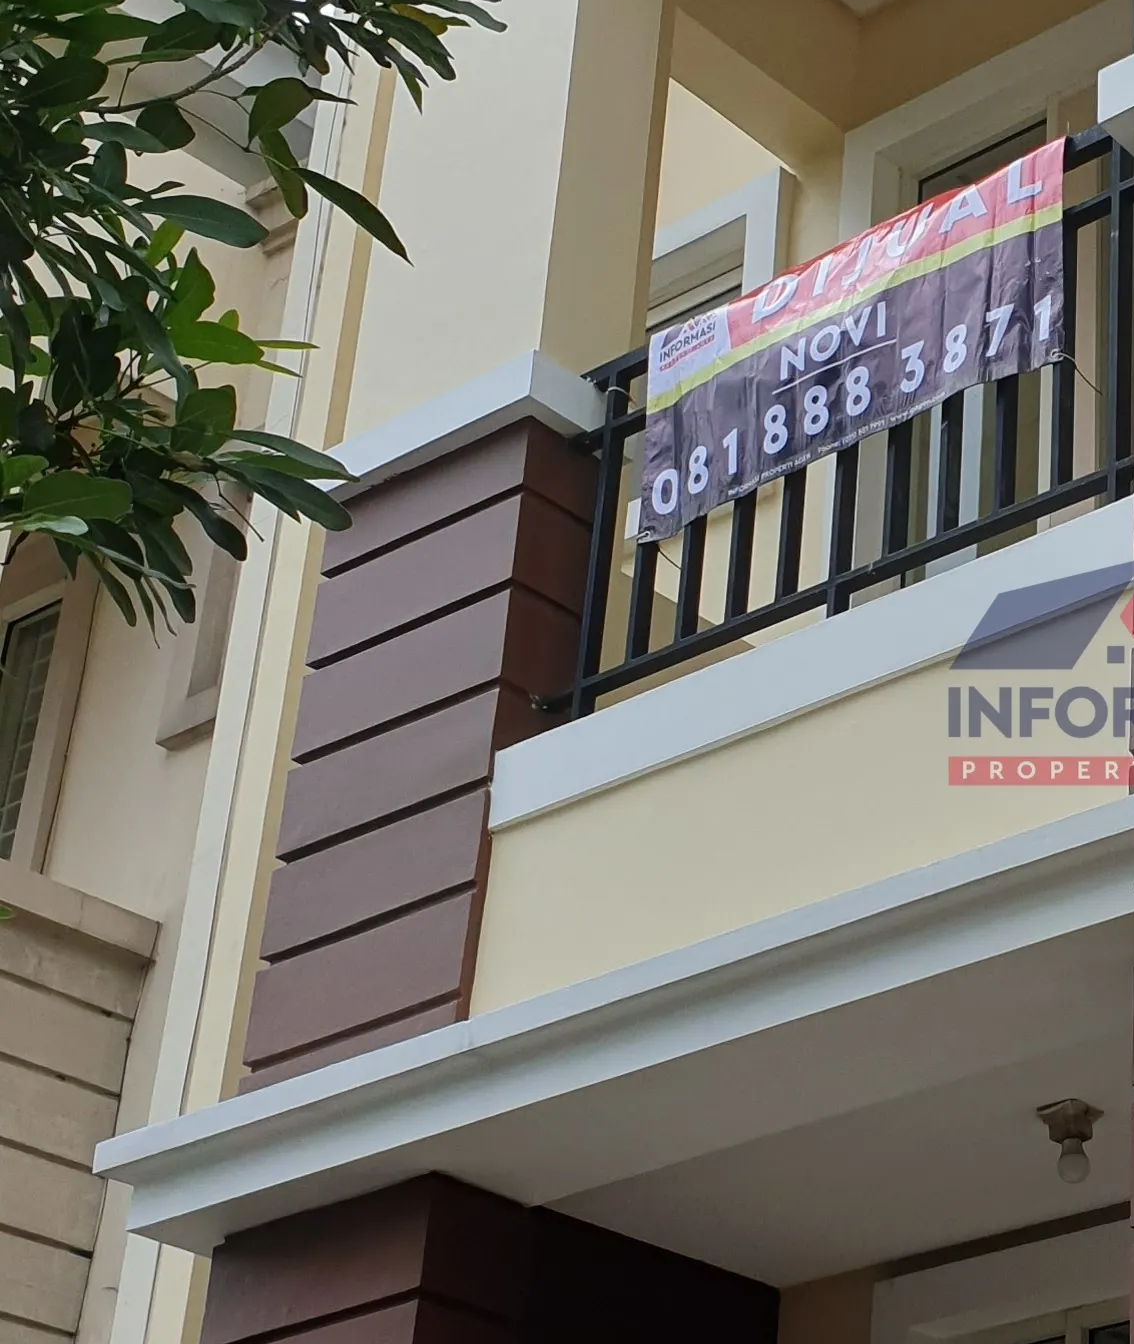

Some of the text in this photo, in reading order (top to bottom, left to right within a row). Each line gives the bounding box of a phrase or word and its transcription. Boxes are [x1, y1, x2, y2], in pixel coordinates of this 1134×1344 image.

[752, 159, 1043, 324] DIJUAL
[659, 320, 717, 363] INFORMASI
[779, 300, 887, 382] NOVI
